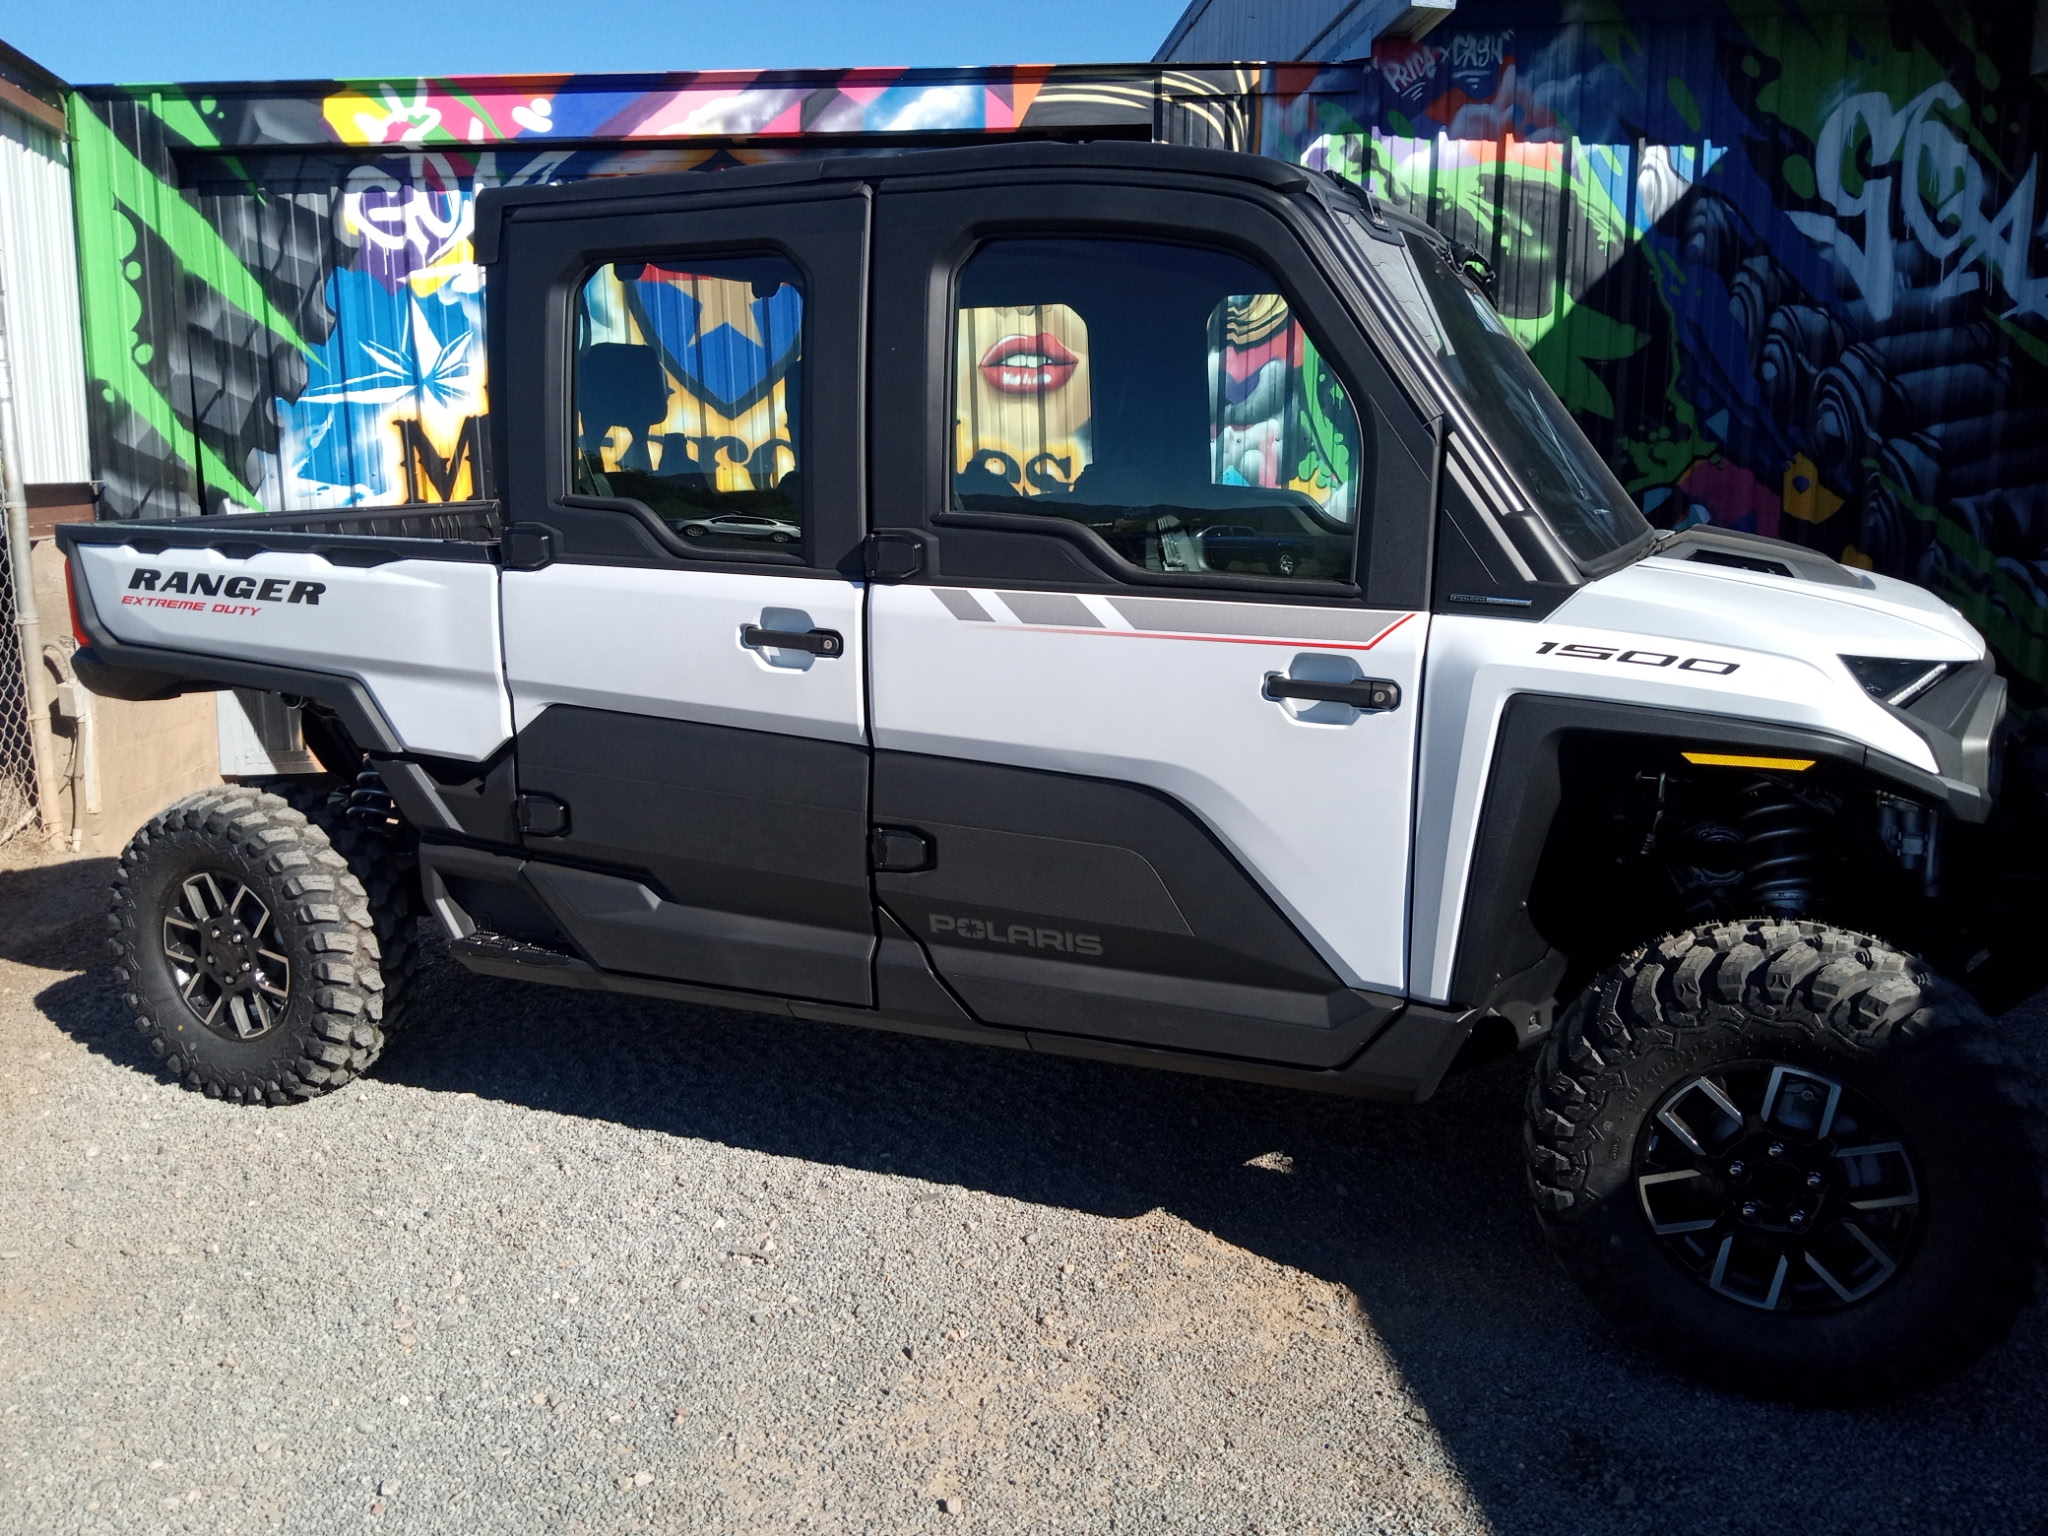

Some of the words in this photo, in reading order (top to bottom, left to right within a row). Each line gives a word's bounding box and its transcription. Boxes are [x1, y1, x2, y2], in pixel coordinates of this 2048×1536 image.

[128, 567, 327, 606] RANGER
[121, 595, 206, 612] EXTREME
[211, 603, 262, 616] DUTY
[1536, 641, 1741, 676] 1500
[928, 912, 1104, 956] POLARIS
